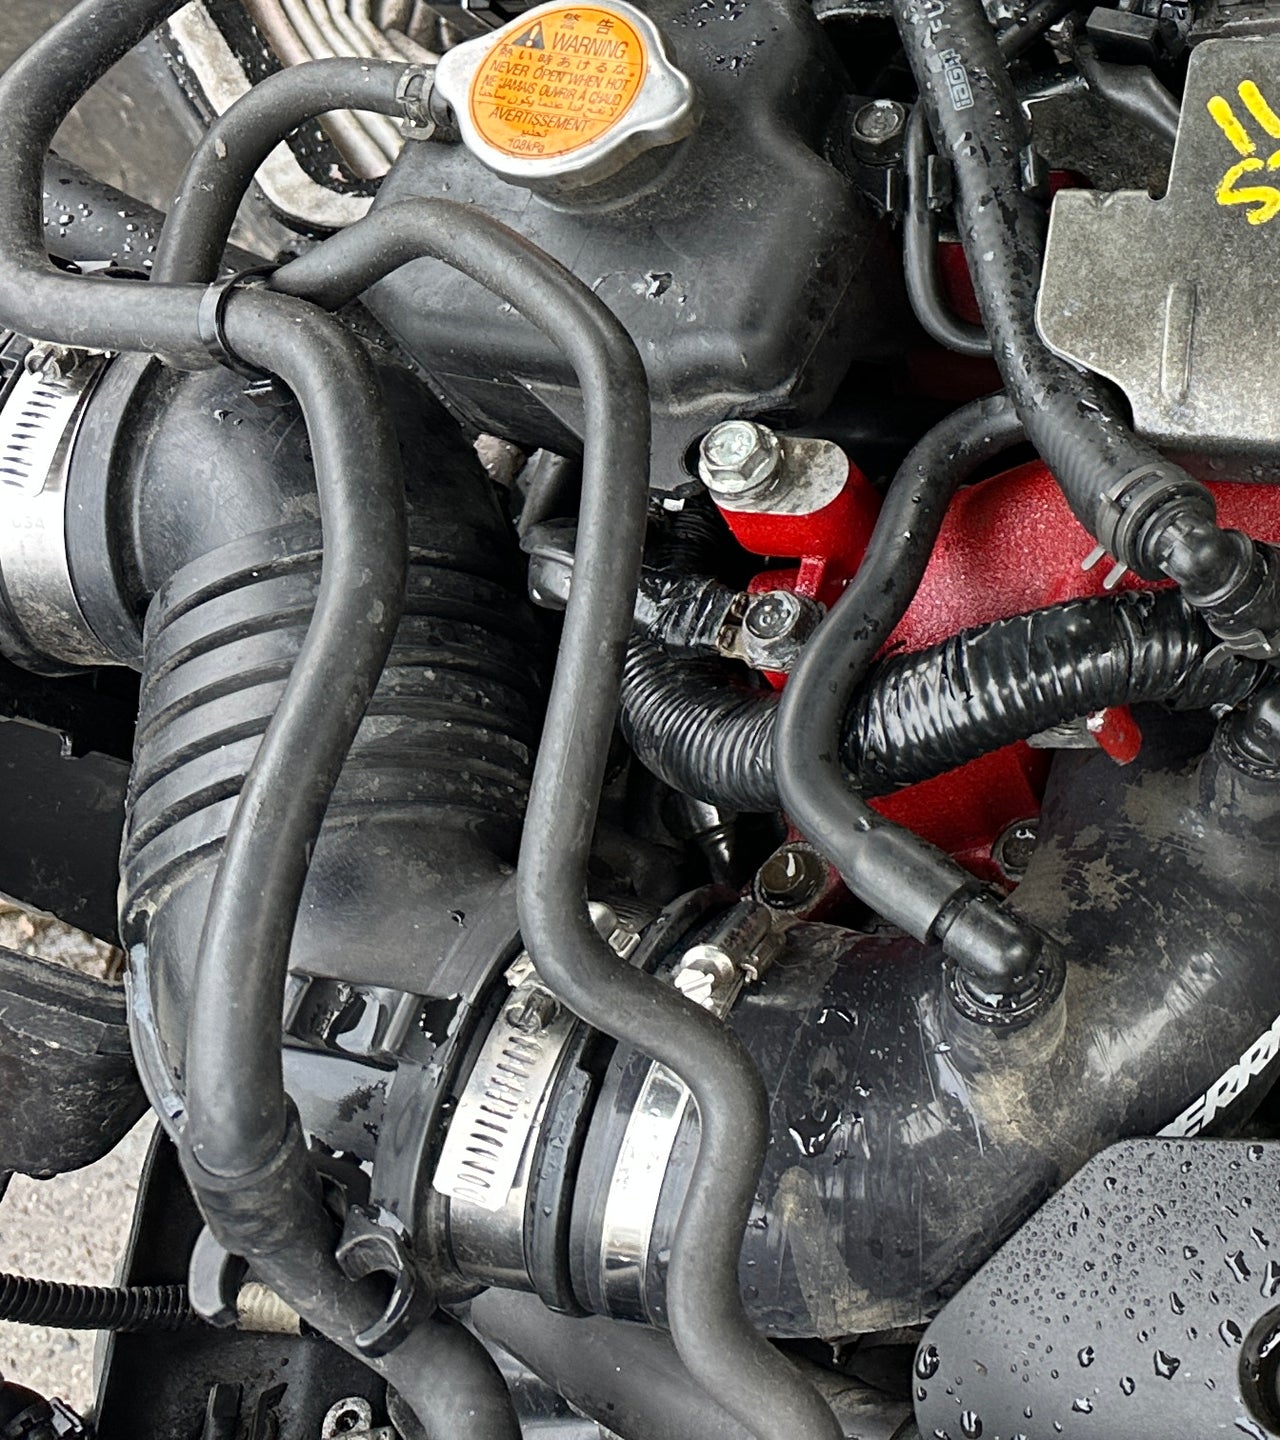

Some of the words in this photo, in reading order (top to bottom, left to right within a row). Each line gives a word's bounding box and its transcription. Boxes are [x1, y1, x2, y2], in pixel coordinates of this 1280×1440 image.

[552, 32, 628, 60] WARNING
[490, 59, 530, 78] NEVER
[533, 66, 568, 83] OPEN
[567, 72, 602, 89] WHEN
[482, 74, 498, 87] NE
[498, 77, 537, 95] JAMAIS
[539, 83, 578, 101] OUVRIR
[588, 91, 623, 106] CHAUD
[489, 106, 590, 132] AVERTISSEMENT
